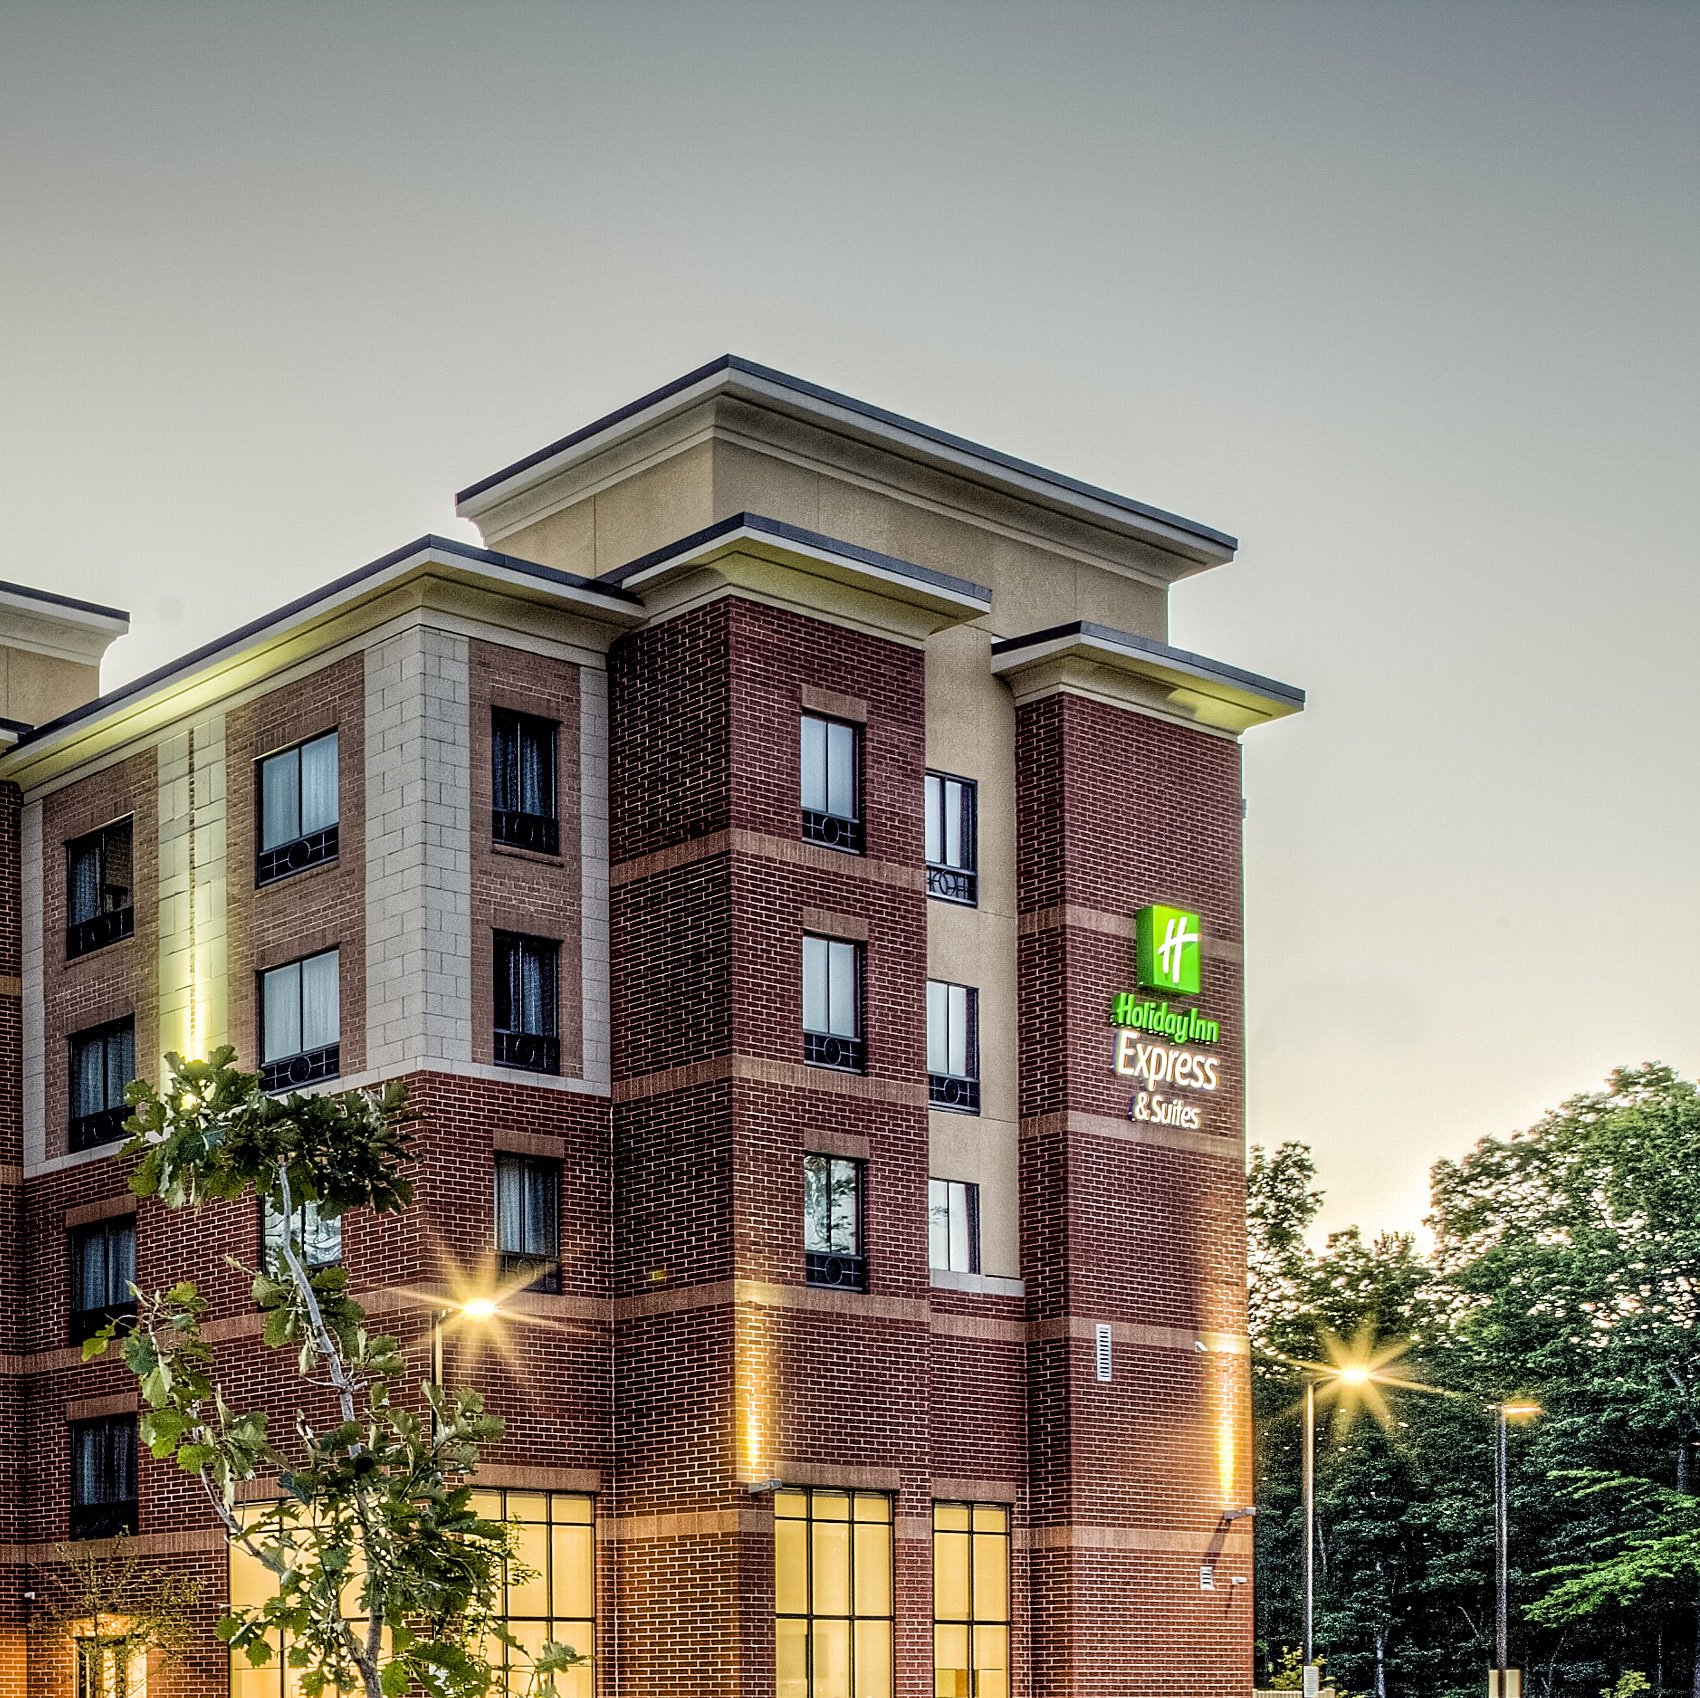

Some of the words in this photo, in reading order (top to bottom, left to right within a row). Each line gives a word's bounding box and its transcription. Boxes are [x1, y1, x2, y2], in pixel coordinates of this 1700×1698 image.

[1157, 917, 1199, 984] H
[1115, 992, 1190, 1043] Holiday
[1189, 1008, 1219, 1042] Inn
[1117, 1030, 1219, 1091] Express
[1135, 1092, 1150, 1121] &
[1151, 1097, 1201, 1129] Suites
